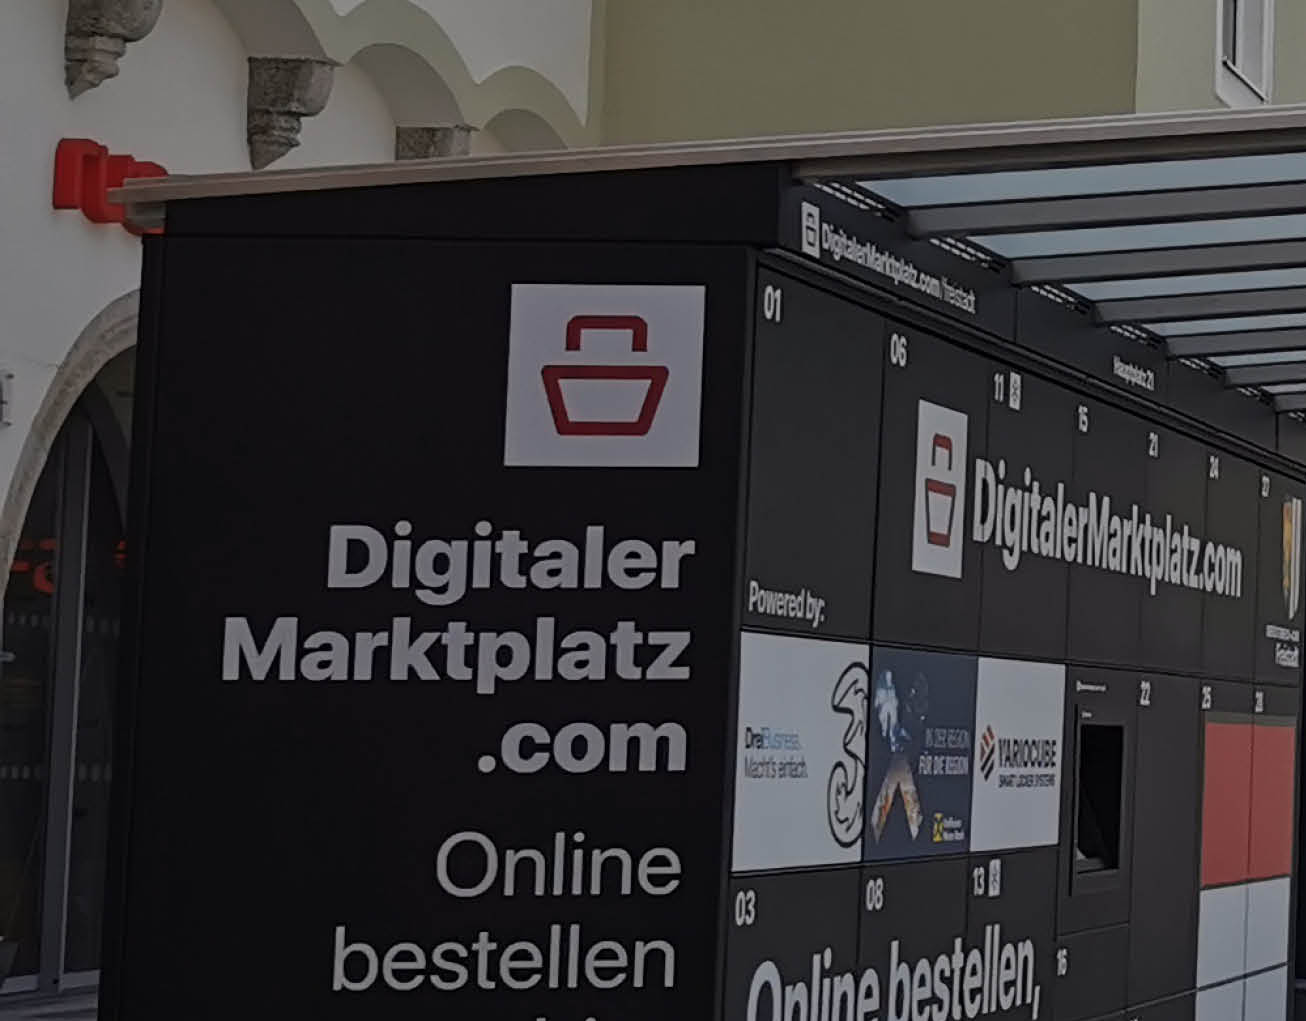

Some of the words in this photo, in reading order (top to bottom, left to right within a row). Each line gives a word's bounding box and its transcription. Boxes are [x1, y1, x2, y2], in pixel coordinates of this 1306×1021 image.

[763, 285, 782, 322] 01
[890, 333, 907, 367] 06
[994, 373, 1004, 401] 11
[973, 458, 1243, 598] DigitalerMarktplatz.com
[327, 520, 696, 606] Digitaler
[748, 580, 805, 618] Powered
[806, 590, 825, 628] by:
[222, 617, 692, 694] Marktplatz
[1140, 681, 1150, 705] 22
[477, 722, 687, 774] .com
[998, 738, 1057, 769] VARIOCUBE
[436, 831, 682, 898] Online
[973, 867, 985, 896] 13
[735, 890, 756, 926] 03
[866, 878, 884, 911] 08
[332, 924, 675, 991] bestellen
